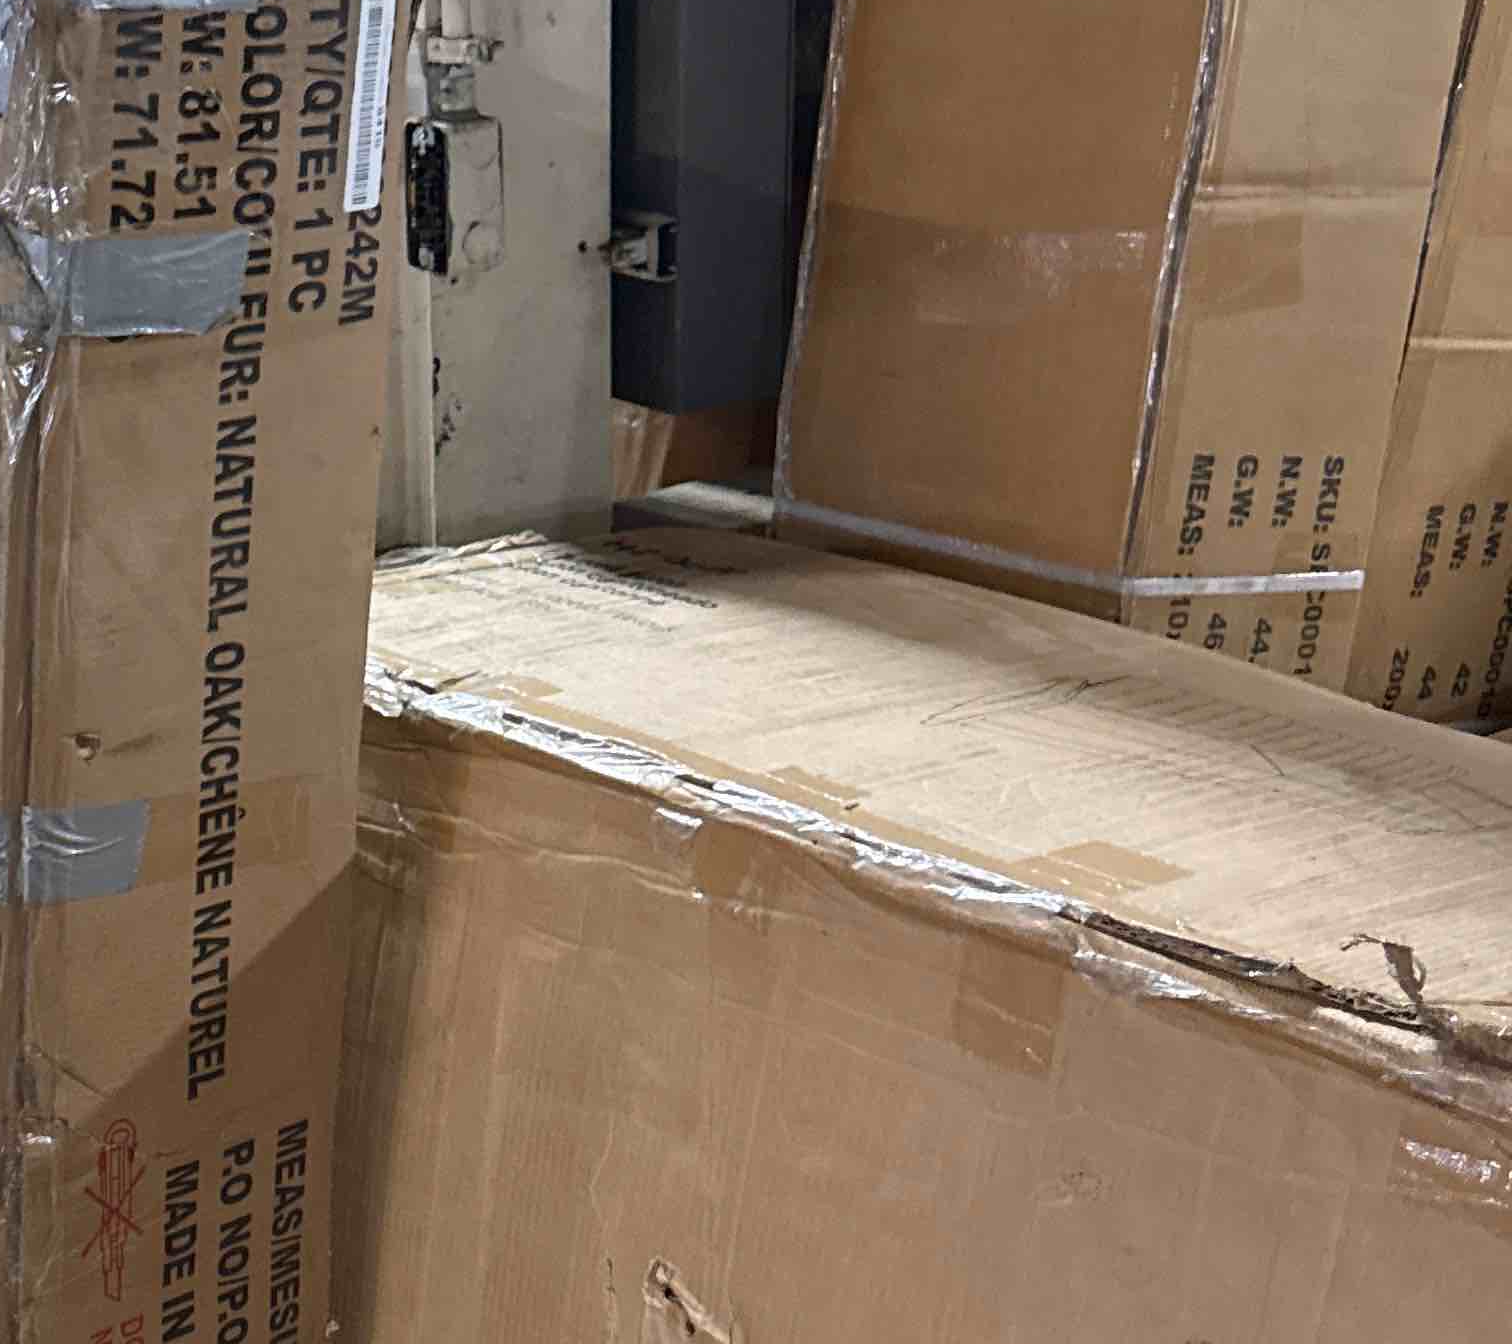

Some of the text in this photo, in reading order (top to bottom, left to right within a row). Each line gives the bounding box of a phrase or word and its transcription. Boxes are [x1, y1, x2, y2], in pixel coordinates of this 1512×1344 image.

[109, 93, 159, 231] 71.72
[172, 89, 221, 220] 81.51
[294, 207, 333, 231] 1
[288, 248, 330, 313] PC
[207, 415, 257, 633] NATURAL
[1178, 453, 1215, 556] MEAS:
[1228, 454, 1259, 529] G.W:
[1271, 455, 1303, 529] N.W:
[1312, 455, 1345, 533] SKU:
[1410, 504, 1445, 598] MEAS:
[195, 641, 246, 895] OAK/CHÊNE
[187, 899, 233, 1102] NATUREL
[162, 1159, 199, 1287] MADE
[161, 1291, 195, 1344] IN
